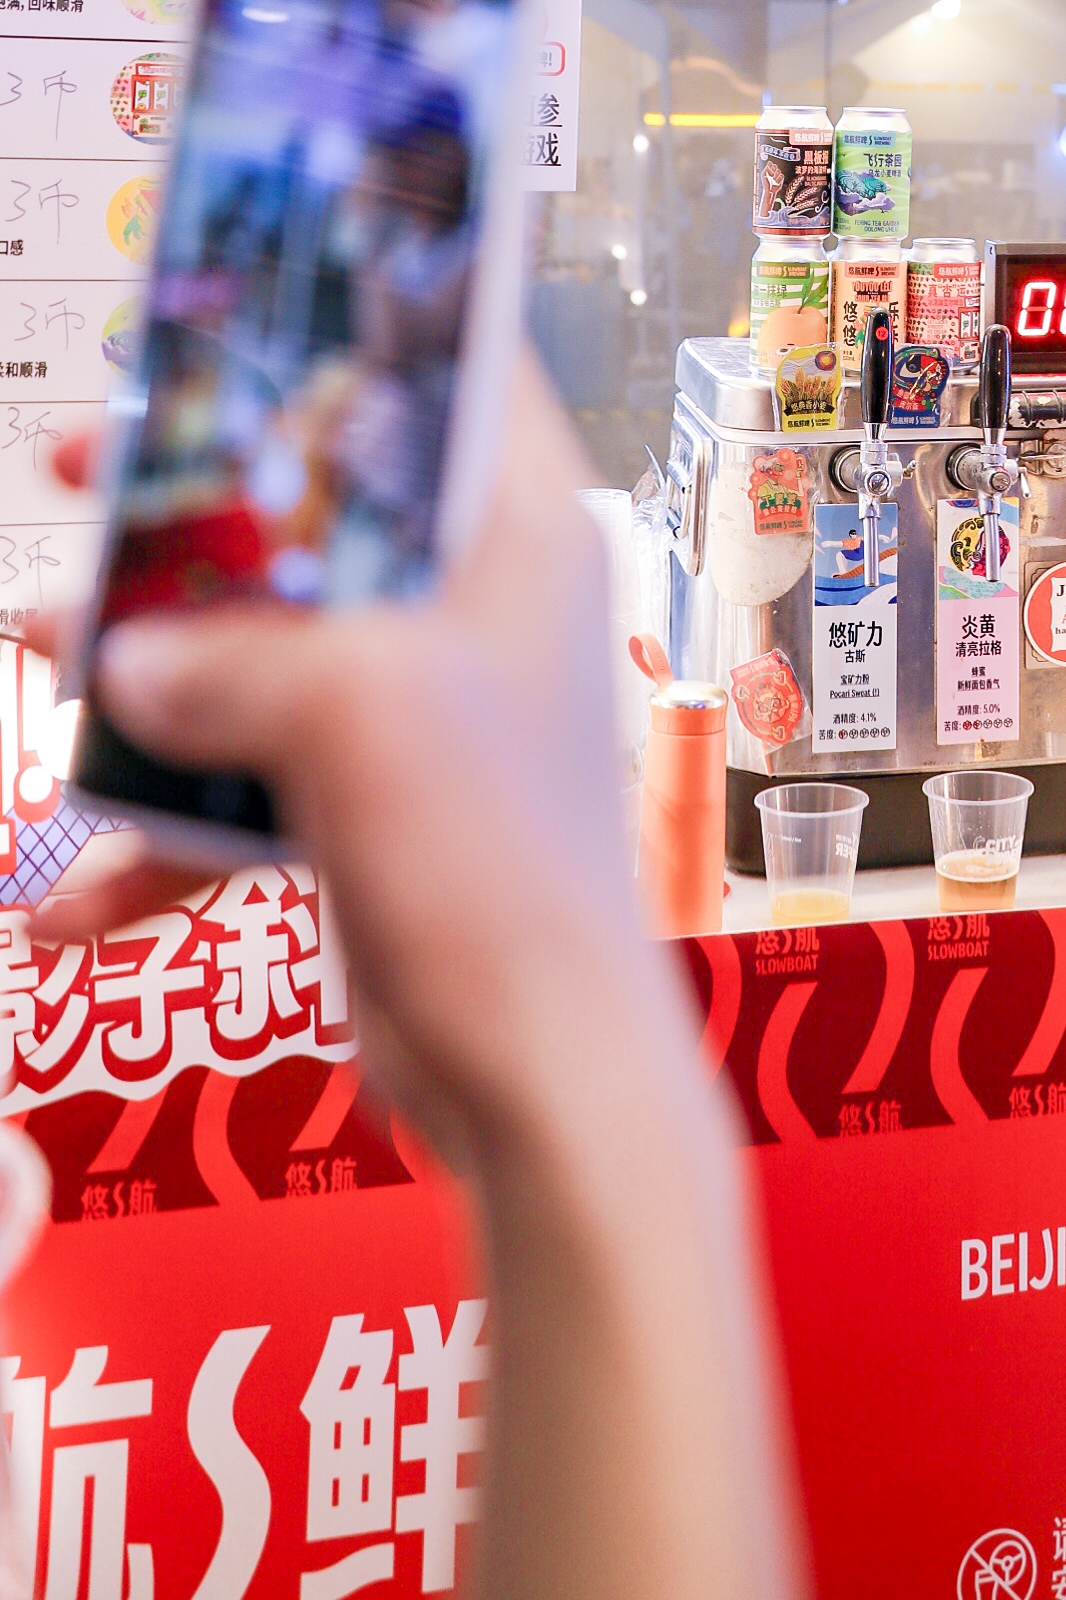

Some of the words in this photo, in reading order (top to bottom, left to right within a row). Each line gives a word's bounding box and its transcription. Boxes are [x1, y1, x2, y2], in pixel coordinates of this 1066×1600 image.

[864, 153, 902, 168] 飞行茶园
[828, 620, 883, 649] 悠矿力
[961, 613, 997, 640] 炎黄
[844, 649, 866, 664] 古斯
[955, 639, 1002, 658] 清亮拉格
[829, 689, 850, 699] Pocari
[851, 688, 871, 698] Sweat
[927, 941, 990, 961] SLOWBOAT
[755, 953, 819, 976] SLOWBOAT
